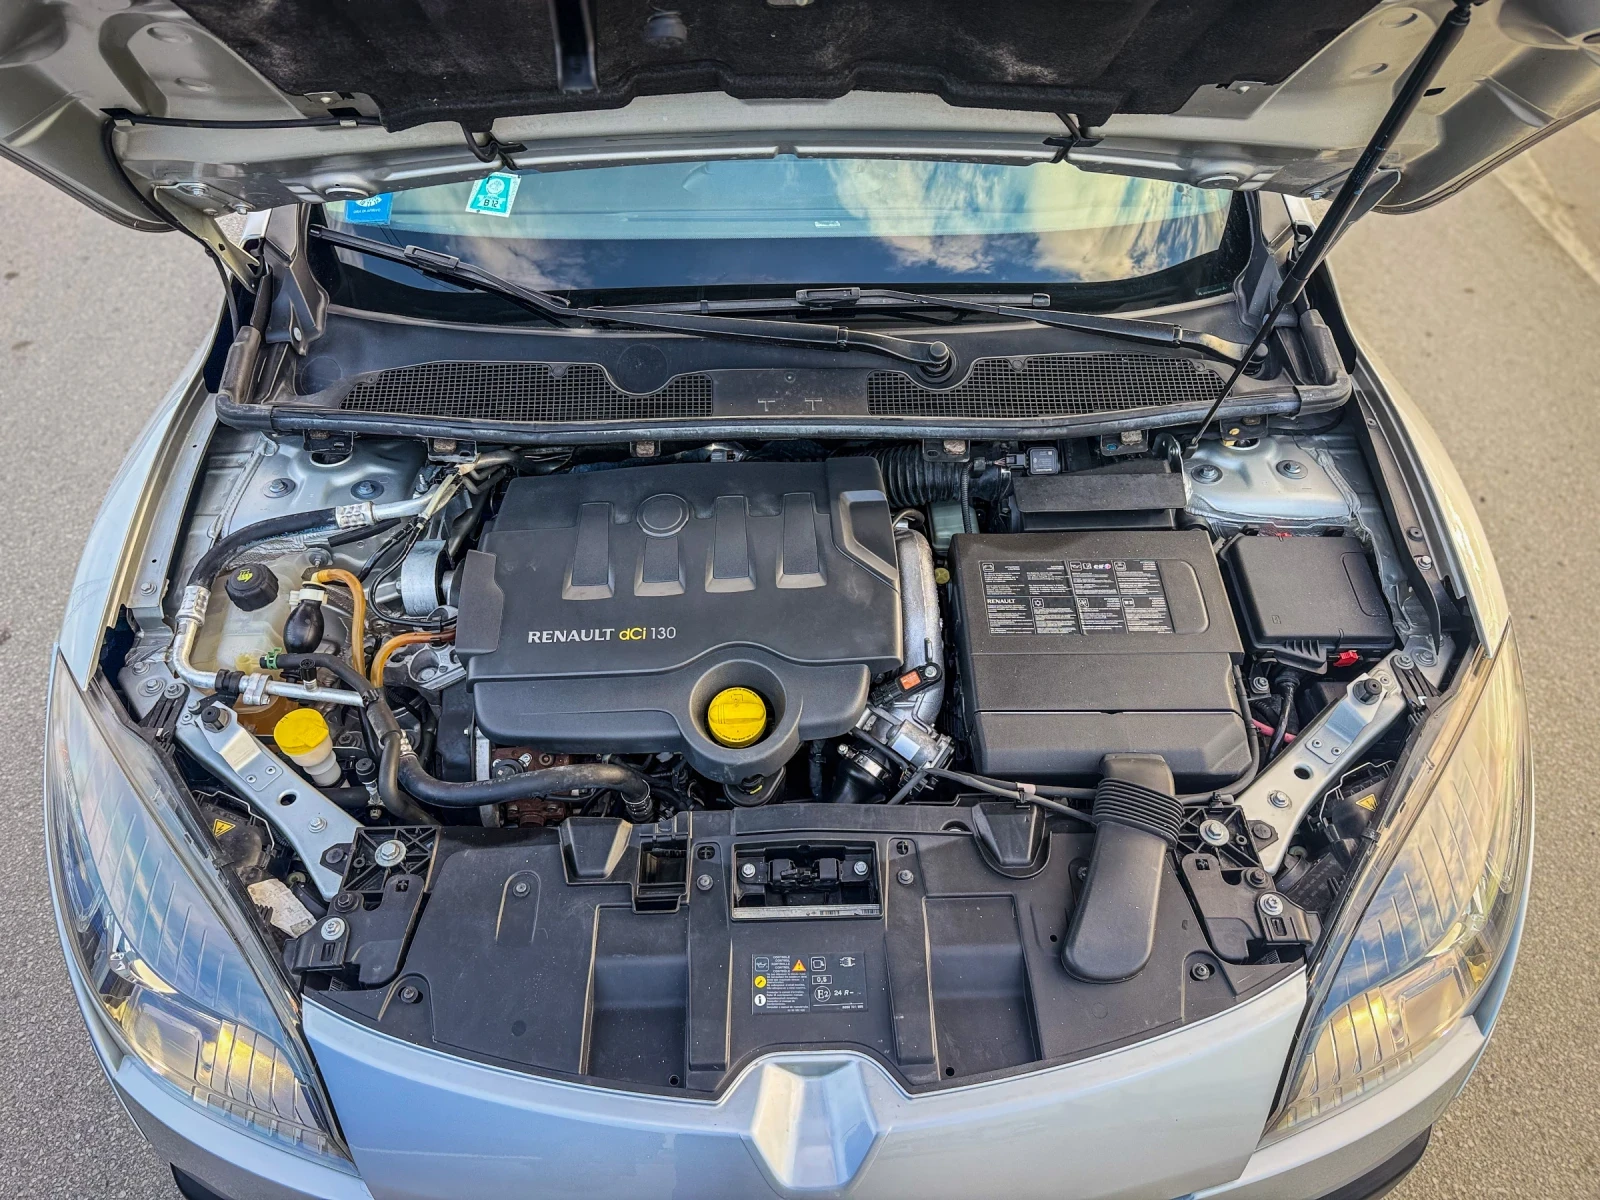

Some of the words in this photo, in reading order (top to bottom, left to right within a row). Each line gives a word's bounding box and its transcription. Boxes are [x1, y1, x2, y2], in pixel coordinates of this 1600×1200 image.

[527, 628, 615, 643] RENAULT
[619, 627, 647, 641] dCi
[650, 626, 677, 640] 130
